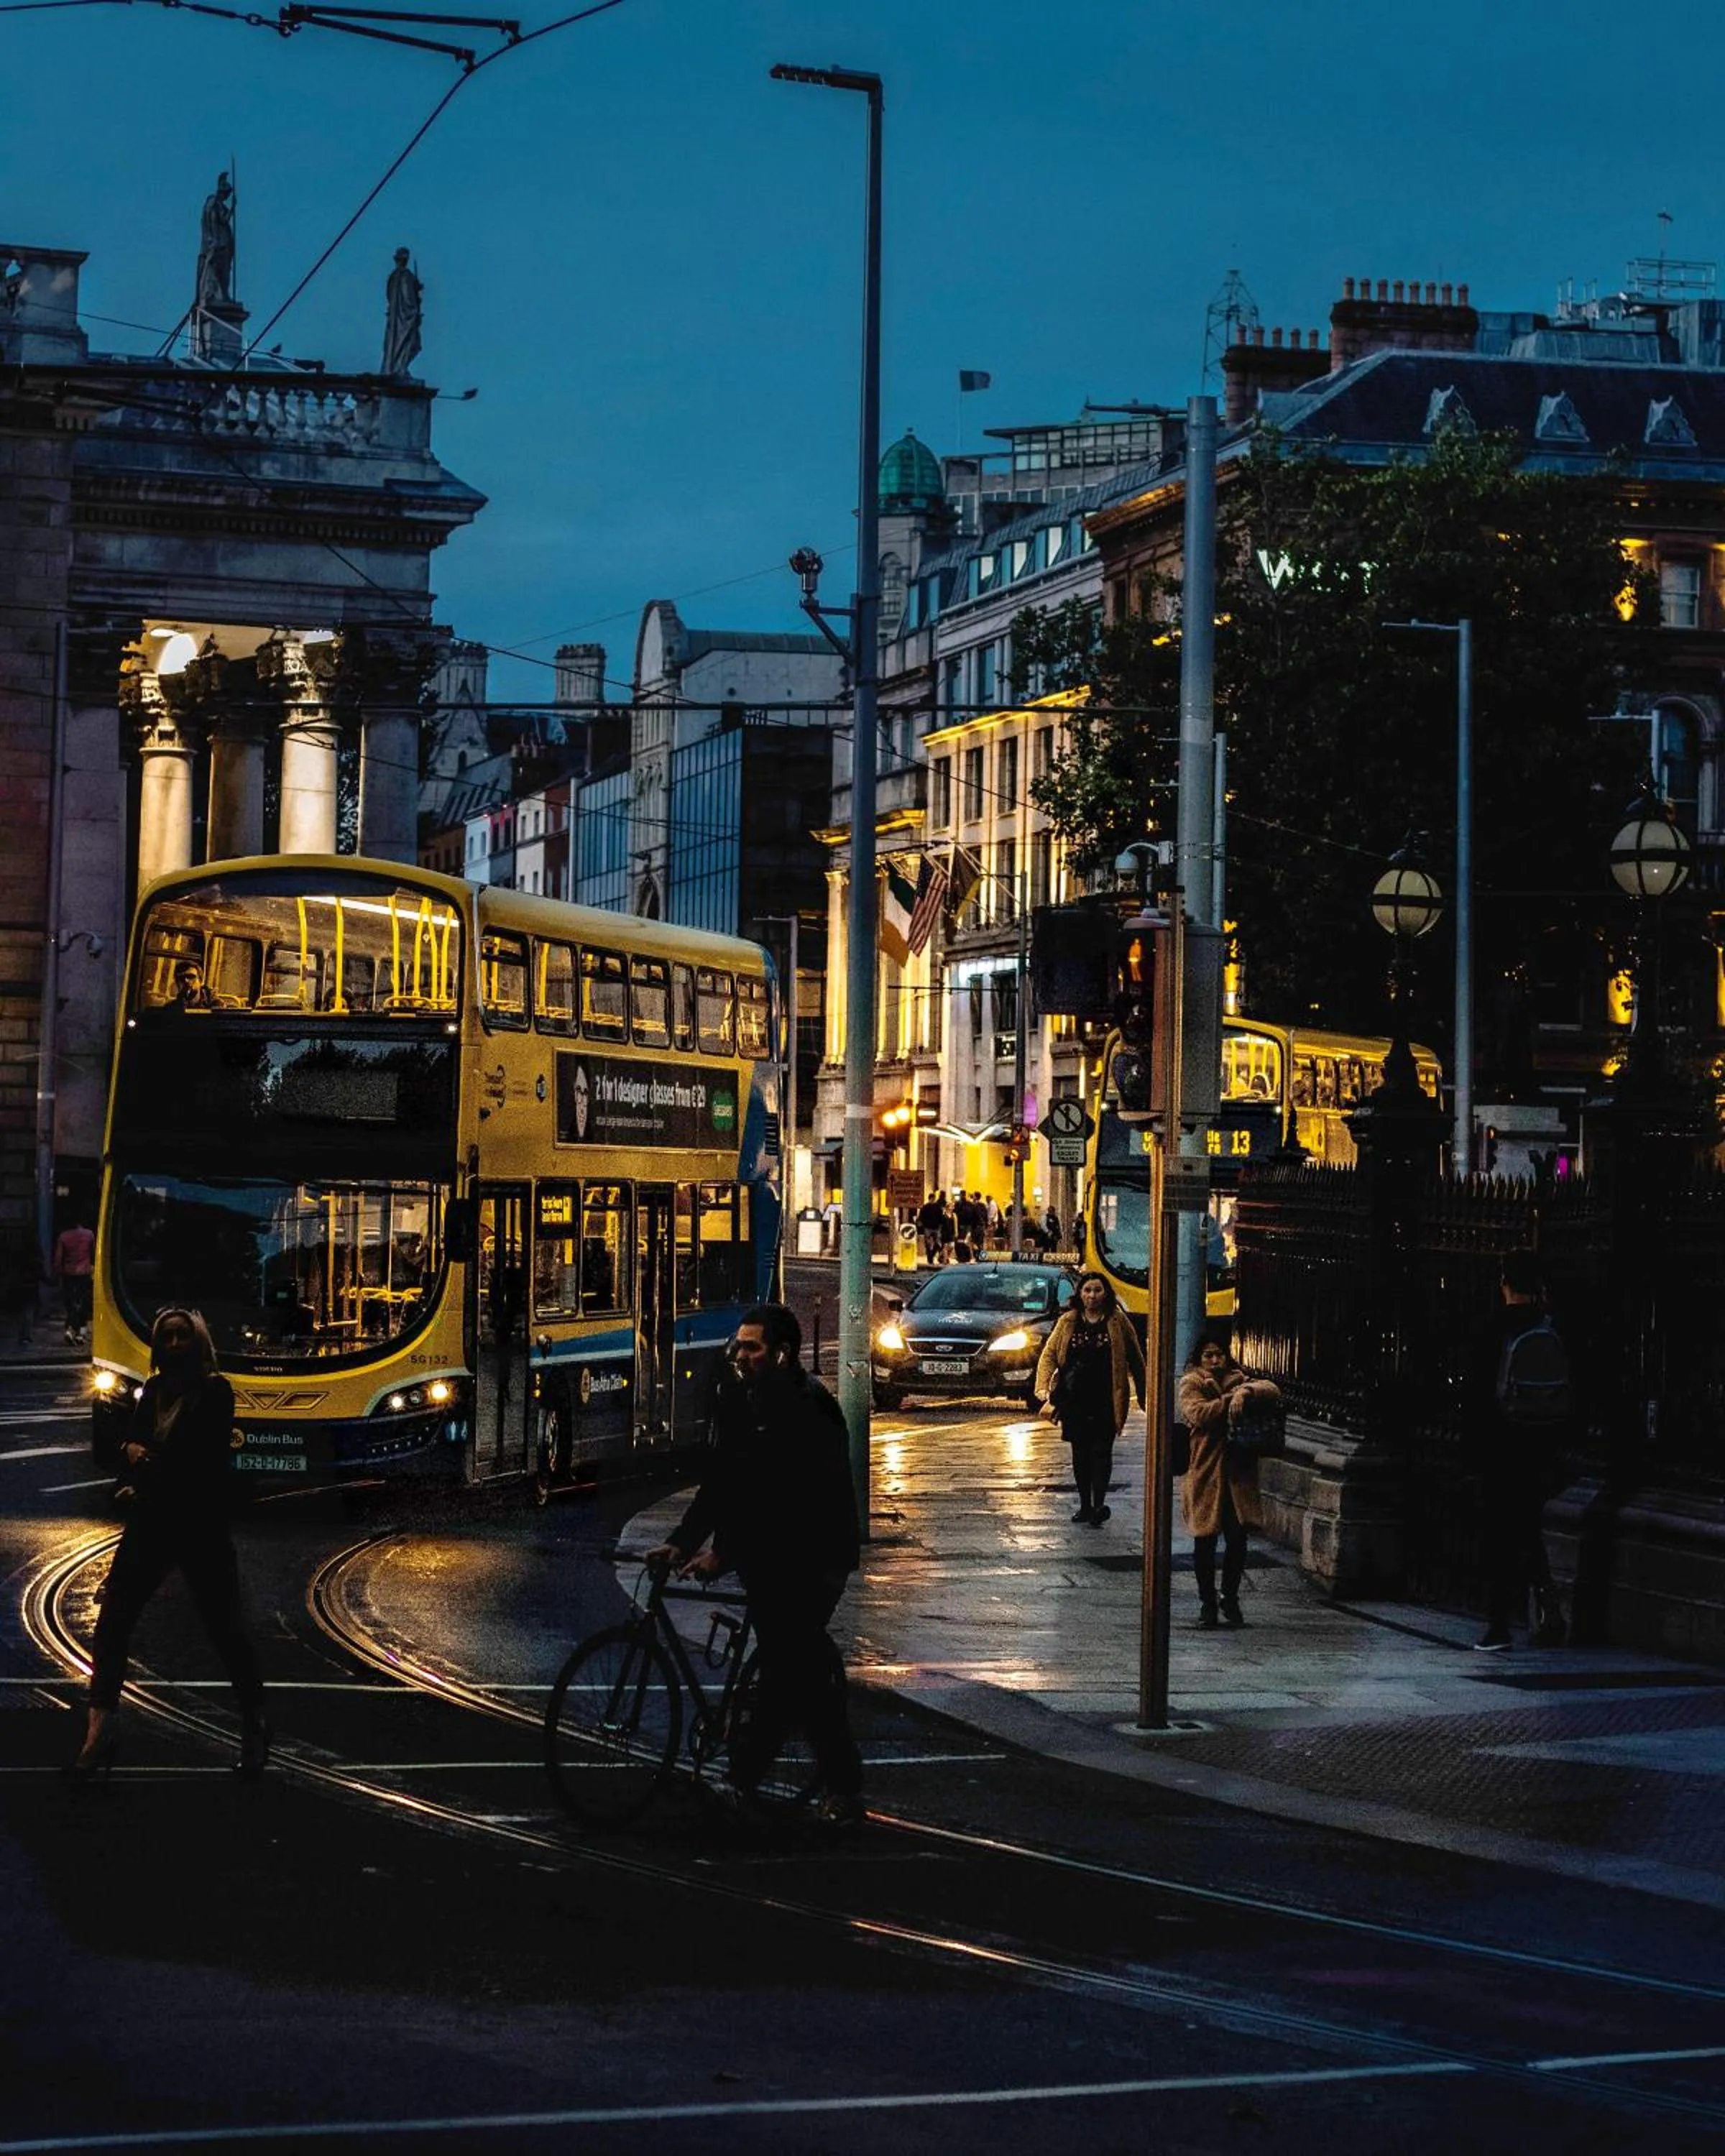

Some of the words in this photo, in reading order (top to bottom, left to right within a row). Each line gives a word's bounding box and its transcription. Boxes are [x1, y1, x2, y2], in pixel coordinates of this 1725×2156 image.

[1256, 549, 1379, 594] WT
[595, 1074, 601, 1101] 2
[618, 1076, 648, 1108] designer
[649, 1079, 675, 1109] glasses
[675, 1081, 691, 1107] from
[1231, 1129, 1251, 1155] 13
[1017, 1251, 1039, 1262] TAXI
[410, 1355, 448, 1365] SG132
[247, 1432, 280, 1445] Dublin
[282, 1434, 303, 1445] Bus
